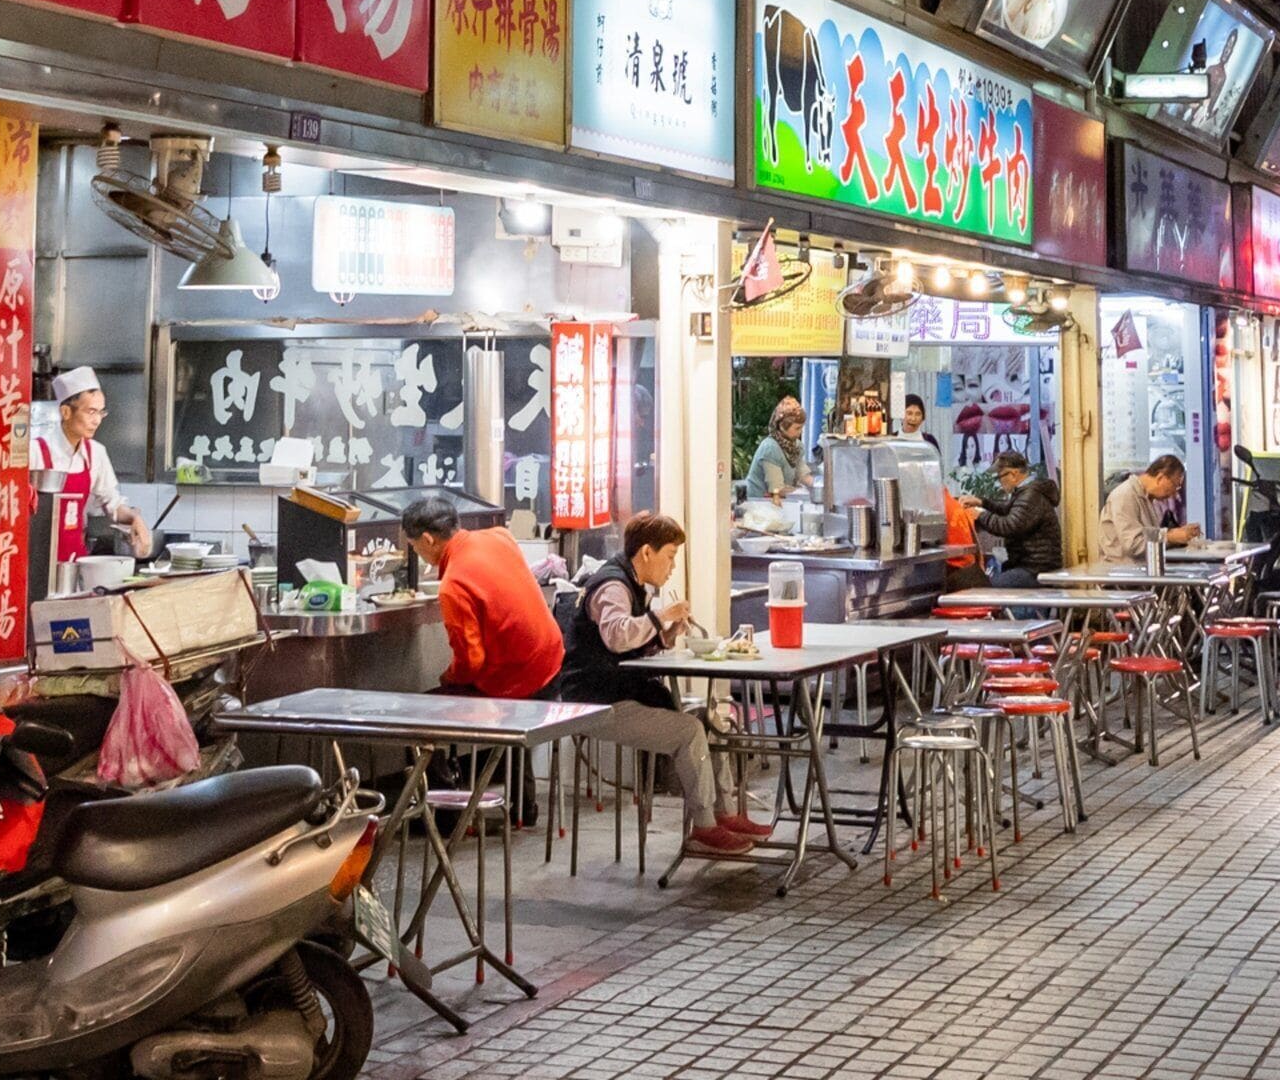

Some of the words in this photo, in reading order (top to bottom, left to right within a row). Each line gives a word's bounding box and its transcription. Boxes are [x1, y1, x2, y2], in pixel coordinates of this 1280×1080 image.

[624, 31, 693, 105] 清泉號
[840, 53, 1031, 235] 天天生炒牛肉
[909, 294, 991, 341] 藥局
